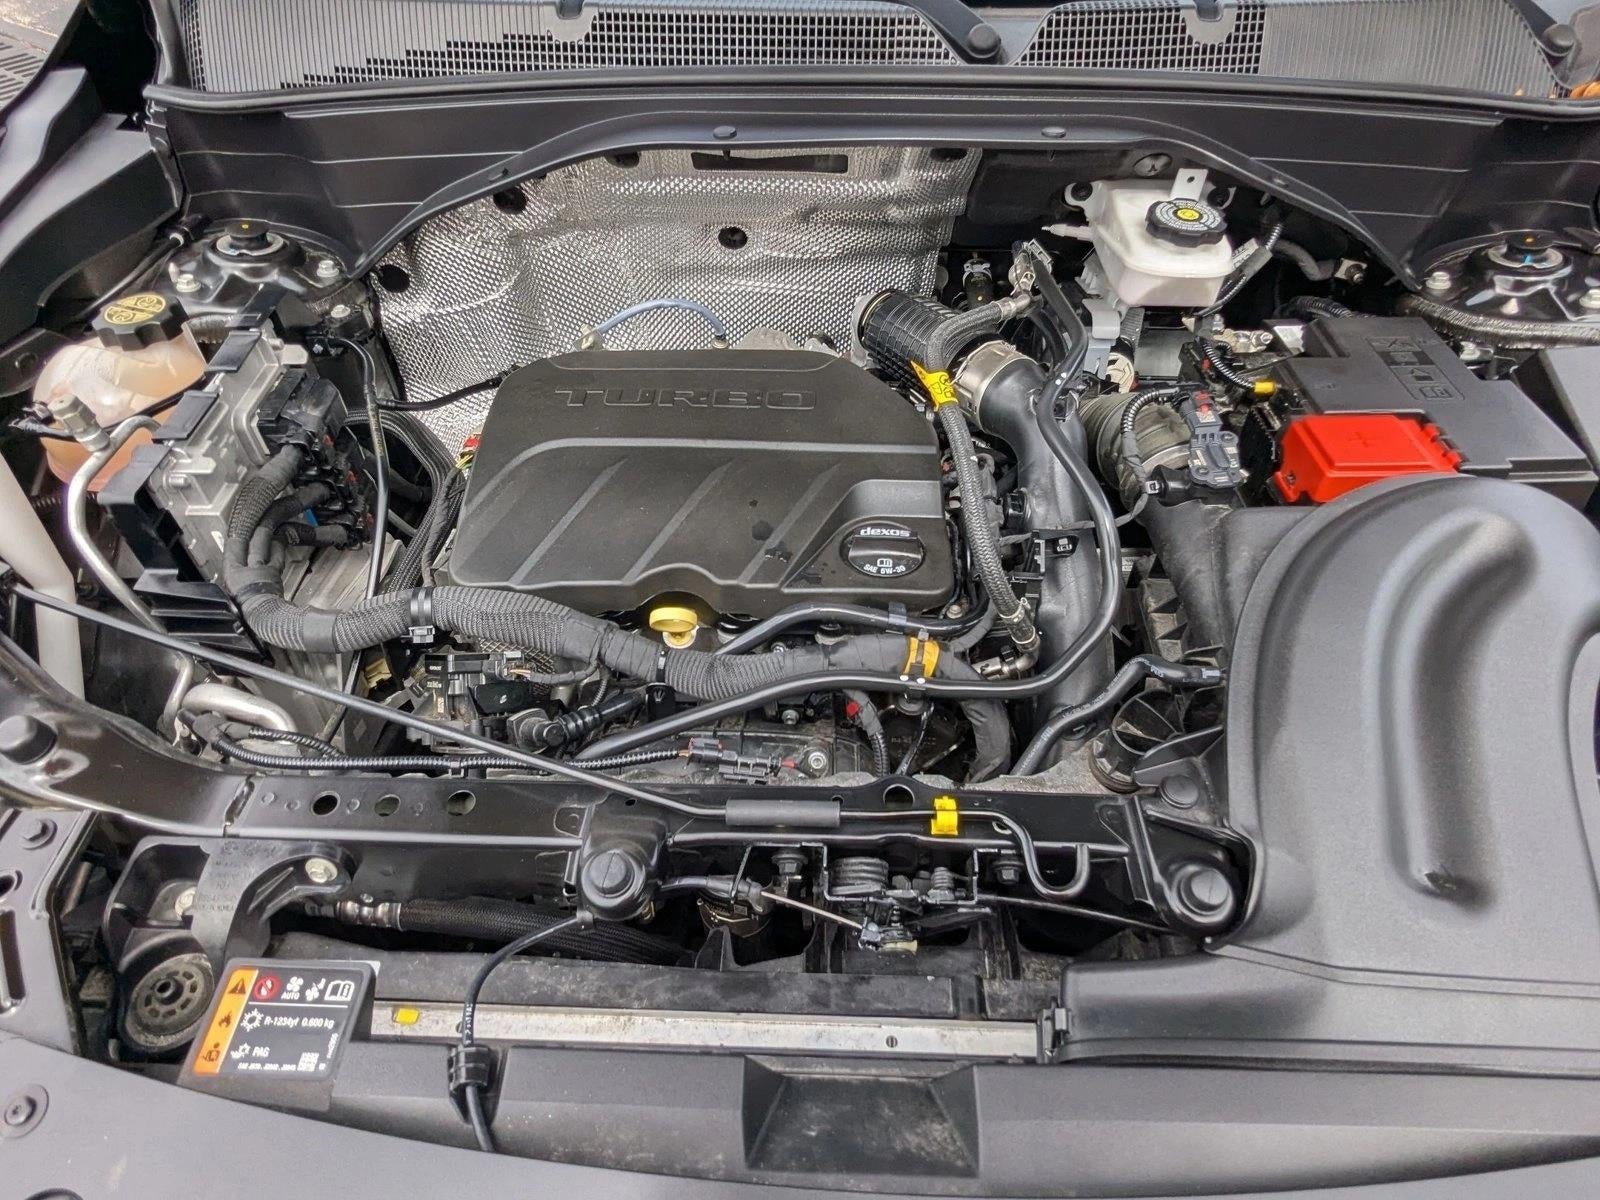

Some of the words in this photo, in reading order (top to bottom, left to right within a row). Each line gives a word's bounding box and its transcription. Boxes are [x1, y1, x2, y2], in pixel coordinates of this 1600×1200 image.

[554, 388, 817, 410] TURBO
[860, 527, 911, 537] dexos
[864, 564, 878, 574] SAE
[880, 564, 906, 575] 5W-30
[281, 992, 299, 1000] AUTO
[264, 1016, 299, 1028] R-1234yf
[301, 1017, 324, 1028] 0.600
[324, 1018, 335, 1029] kg
[252, 1046, 270, 1057] PAG
